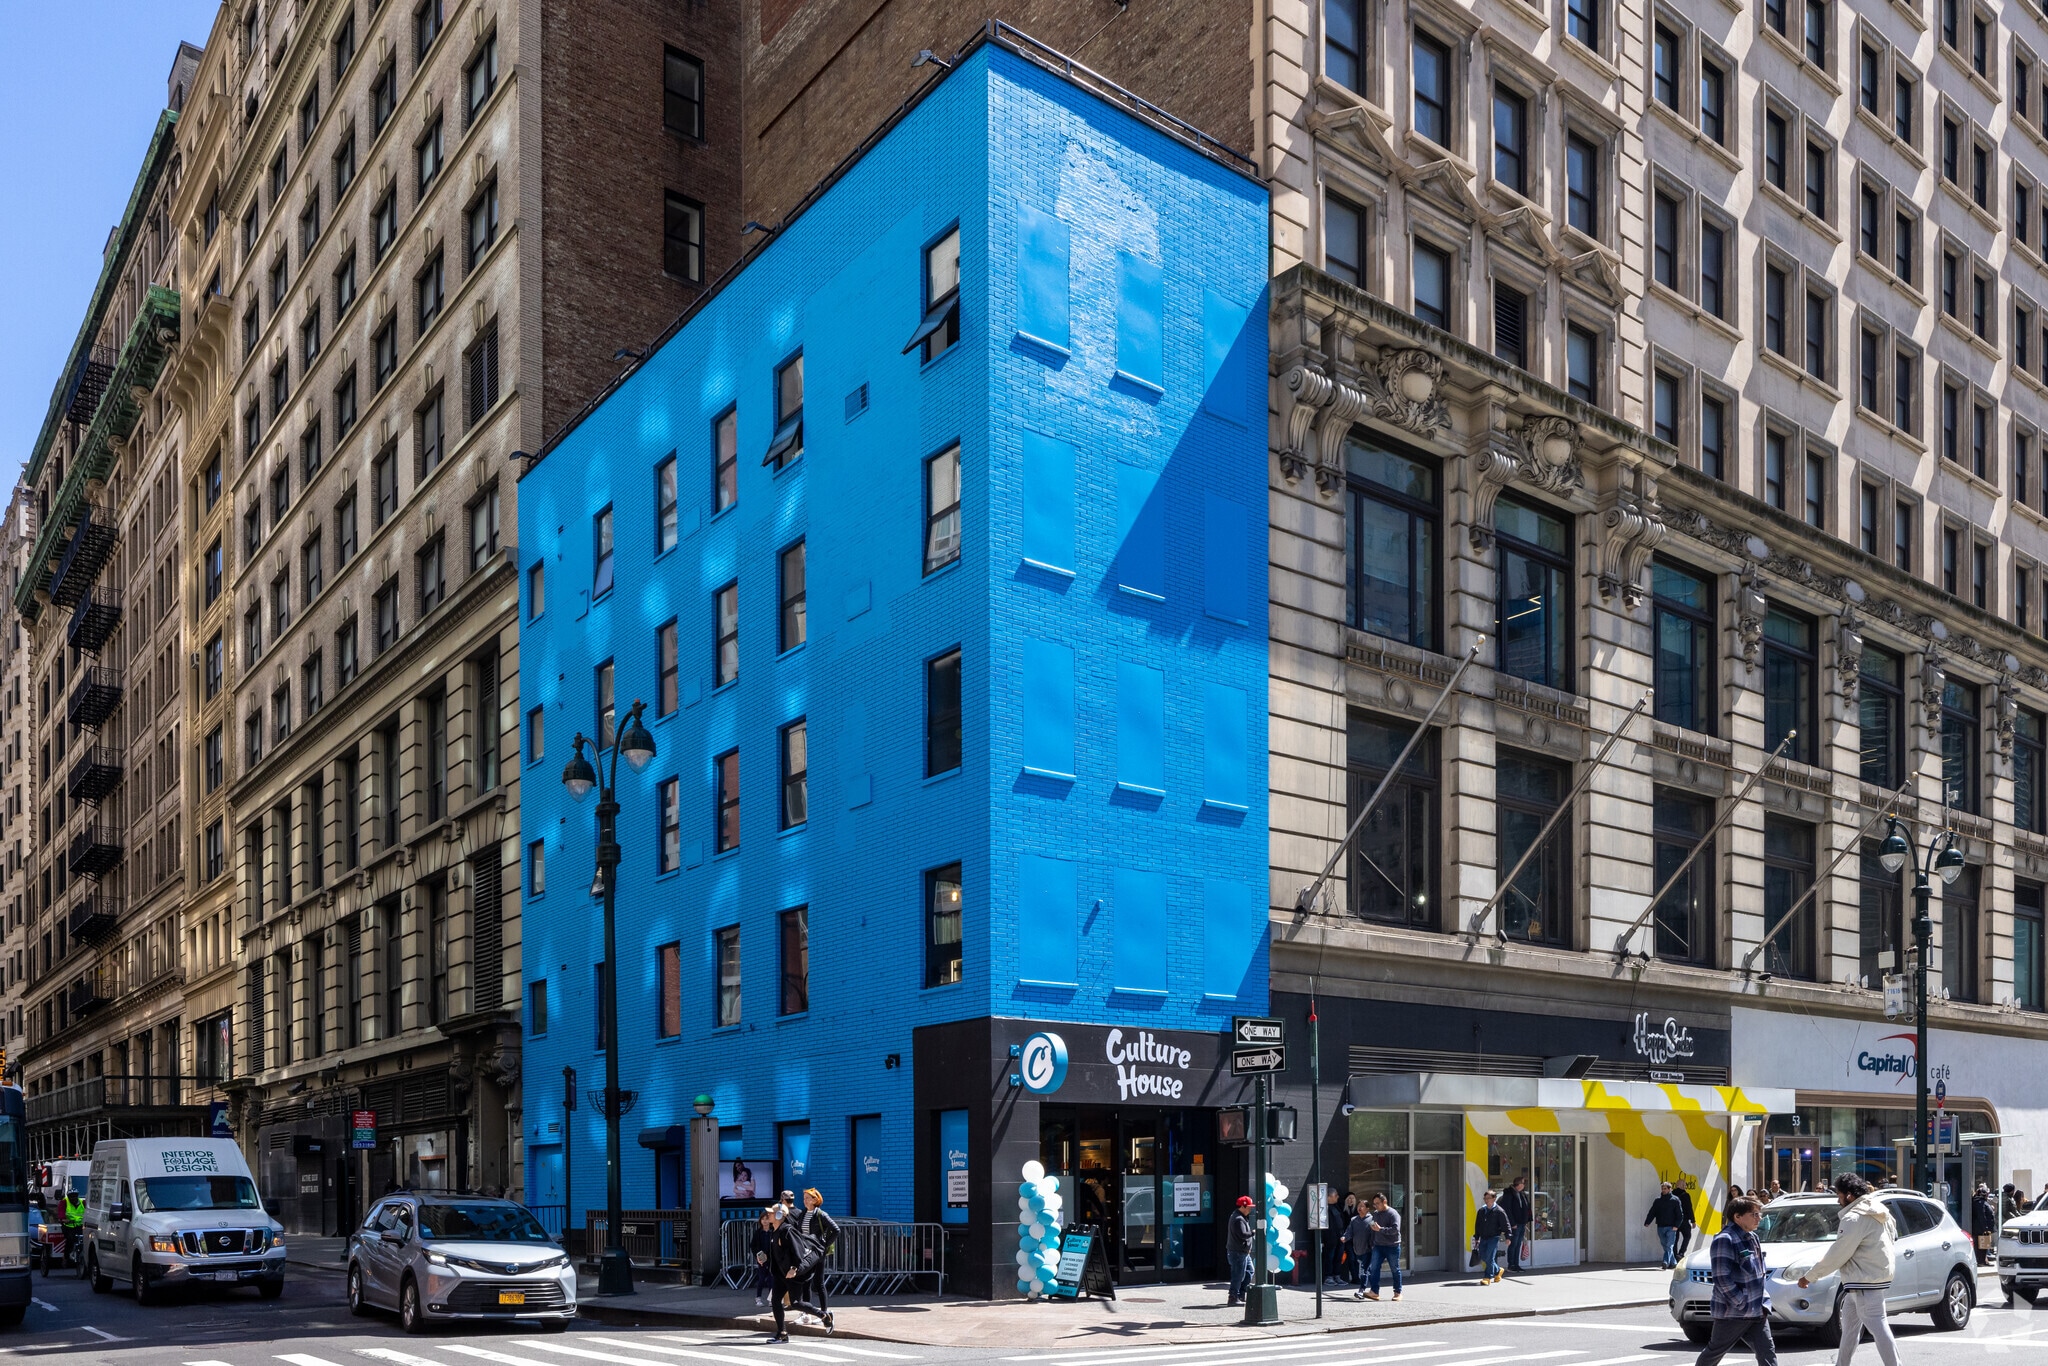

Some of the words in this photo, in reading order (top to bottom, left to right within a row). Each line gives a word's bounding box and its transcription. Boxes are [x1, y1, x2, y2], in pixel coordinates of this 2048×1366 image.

[1244, 1026, 1257, 1036] ONE
[1262, 1027, 1277, 1036] WAY
[1633, 1012, 1667, 1063] Happy
[1664, 1017, 1694, 1057] Socks
[1106, 1029, 1191, 1069] Culture
[1241, 1057, 1255, 1066] ONE
[1261, 1055, 1277, 1064] WAY
[1930, 1064, 1950, 1080] café
[1117, 1065, 1183, 1101] House
[1792, 1115, 1801, 1126] 53
[161, 1150, 214, 1158] INTERIOR
[948, 1149, 968, 1160] Culture
[163, 1157, 217, 1165] FOLIAGE
[863, 1156, 880, 1165] Culture
[951, 1159, 966, 1169] House
[165, 1164, 212, 1173] DESIGN
